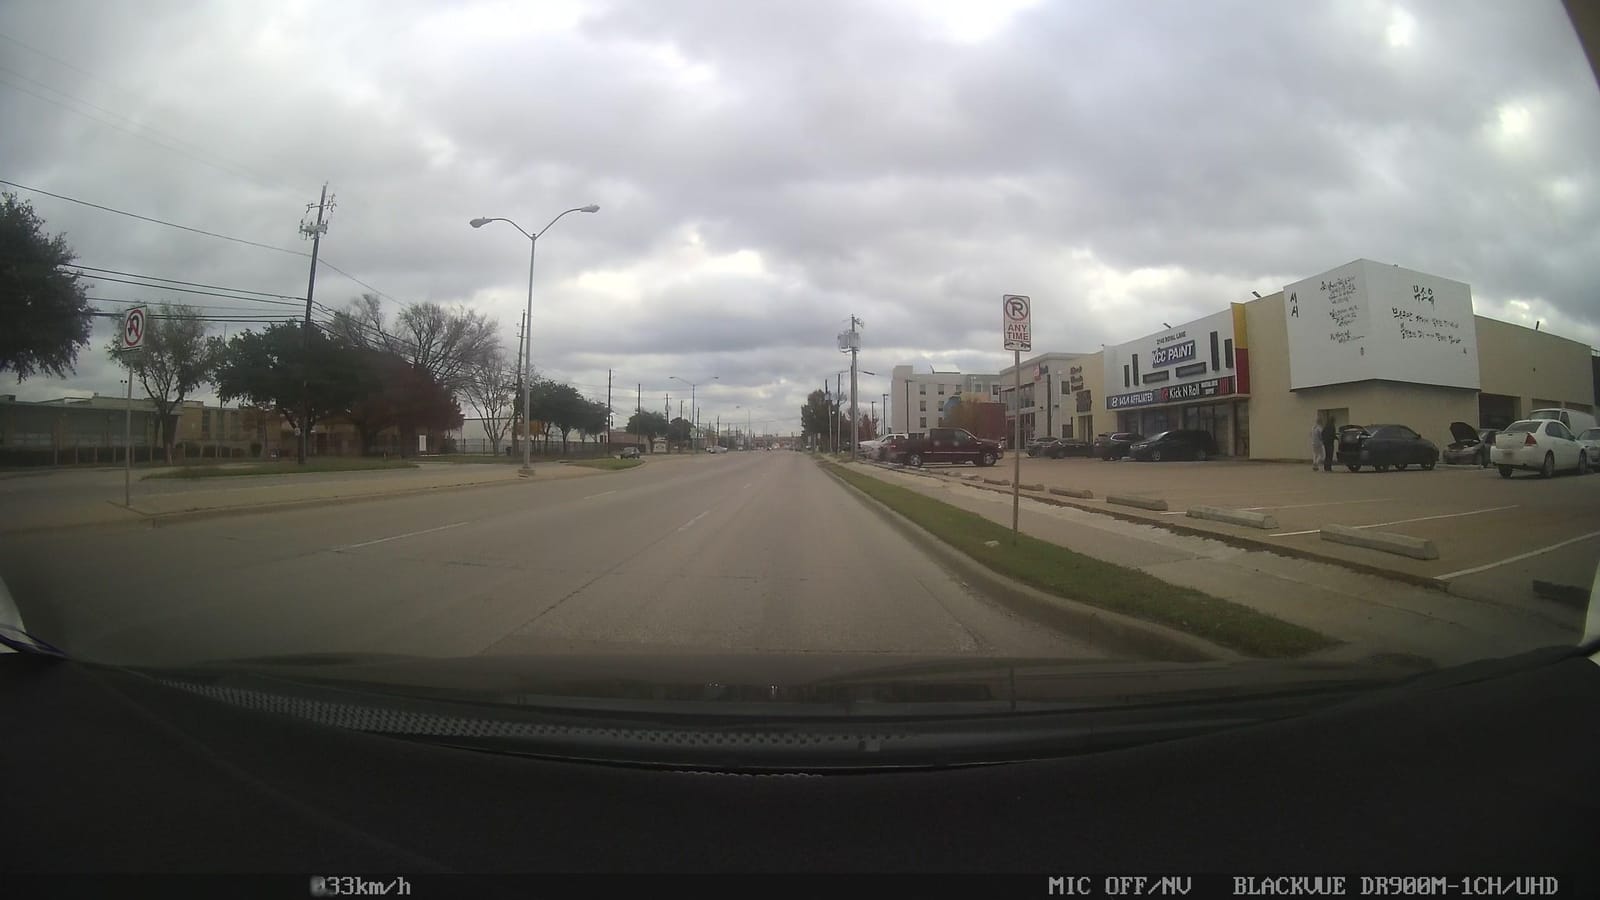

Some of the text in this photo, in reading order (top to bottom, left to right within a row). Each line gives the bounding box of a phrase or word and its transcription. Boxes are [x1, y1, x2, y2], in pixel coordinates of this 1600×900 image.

[1007, 324, 1027, 332] ANY
[1007, 332, 1029, 340] TIME
[1152, 343, 1194, 365] KCC PAINT
[1169, 387, 1182, 399] Kick
[1182, 385, 1188, 397] N
[1188, 383, 1200, 396] Roll
